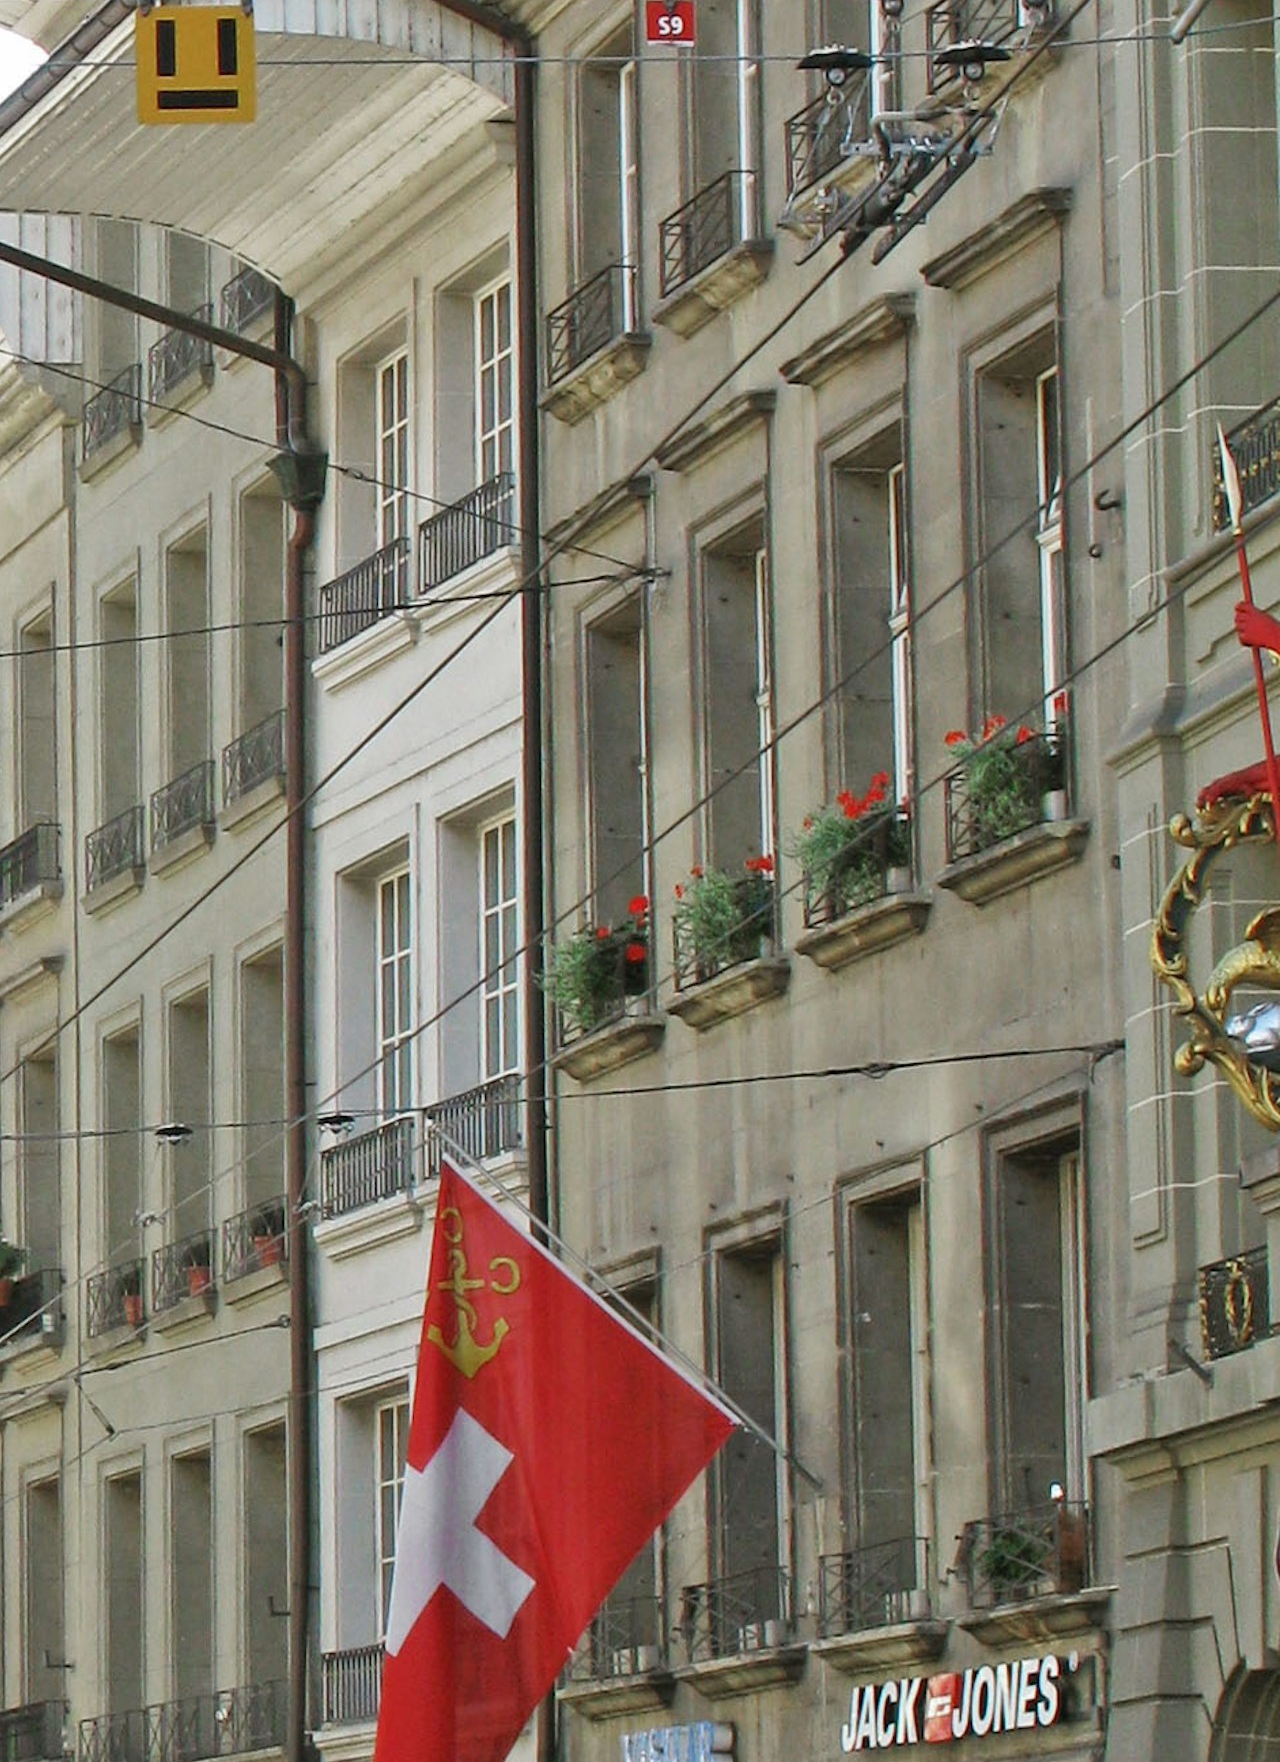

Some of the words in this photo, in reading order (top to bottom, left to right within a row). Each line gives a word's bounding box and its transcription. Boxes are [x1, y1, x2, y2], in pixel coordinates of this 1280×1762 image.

[657, 15, 684, 35] S9
[841, 1677, 921, 1753] JACK
[951, 1654, 1060, 1739] JONES
